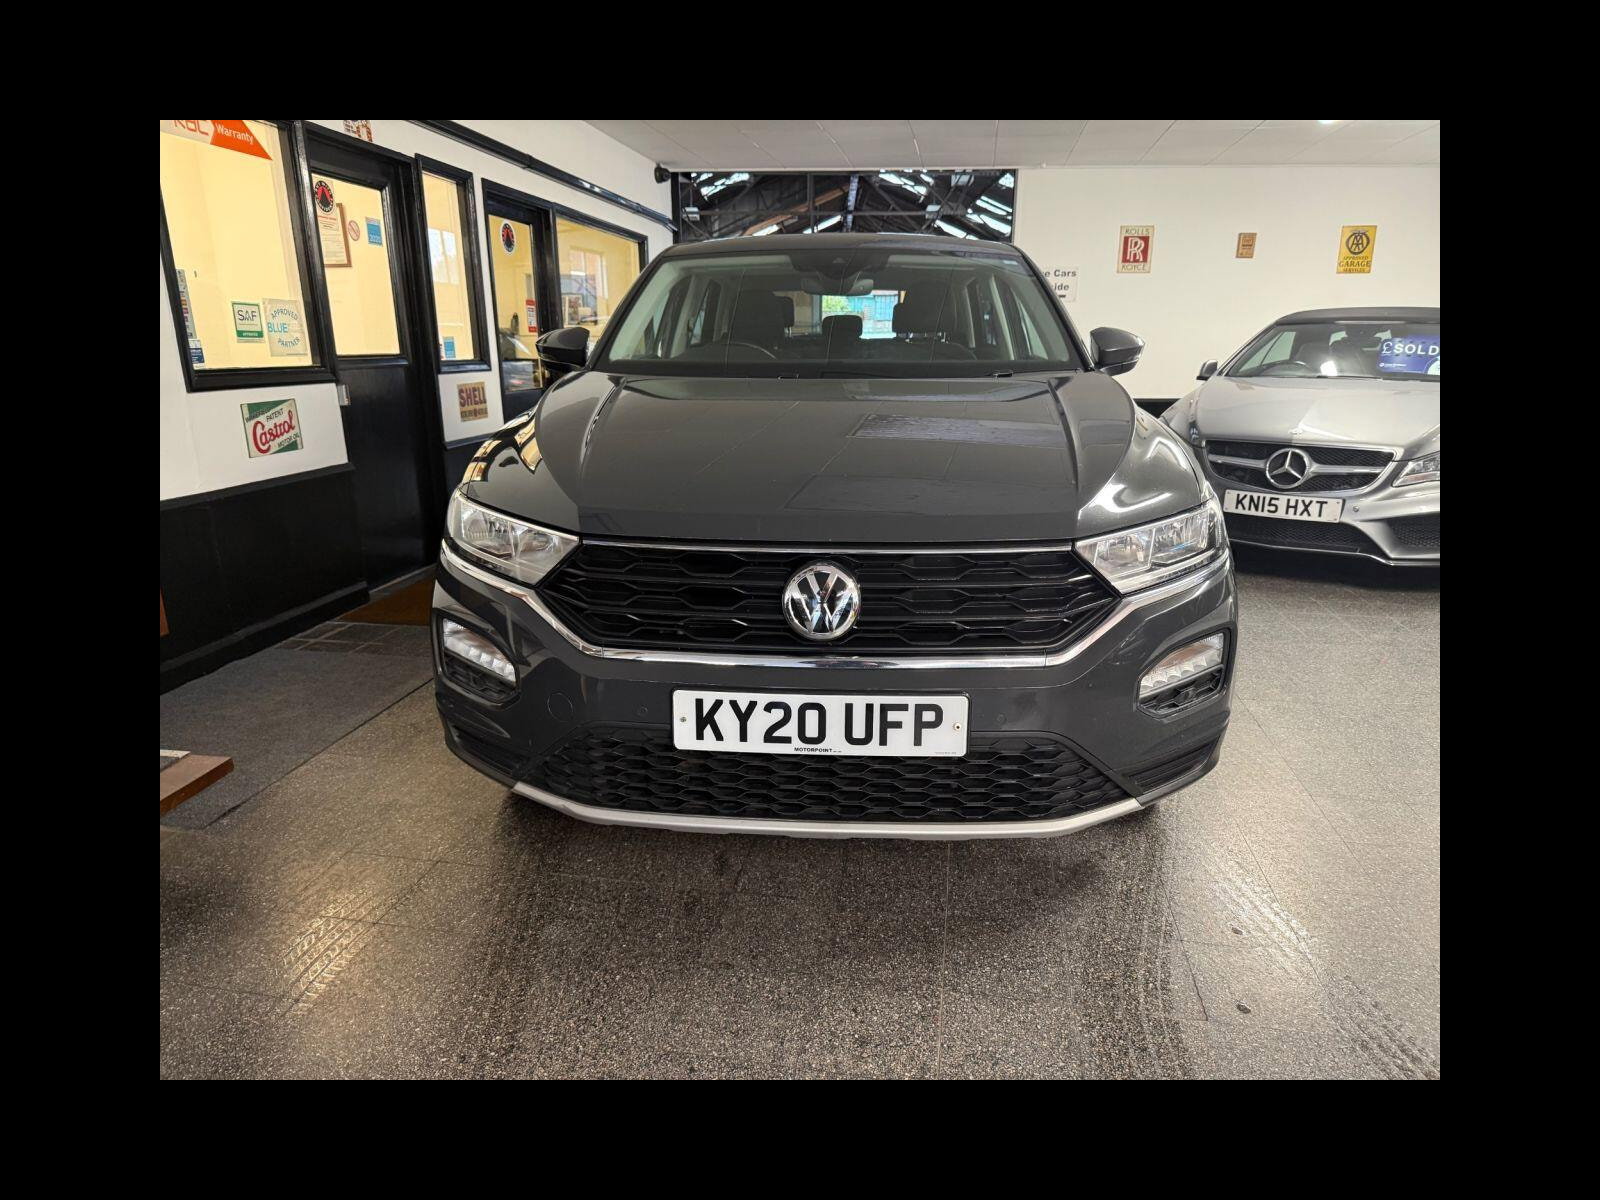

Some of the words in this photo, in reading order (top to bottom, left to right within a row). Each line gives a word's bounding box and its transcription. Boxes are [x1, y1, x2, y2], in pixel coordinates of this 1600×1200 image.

[215, 122, 254, 146] Warranty
[1124, 227, 1150, 235] ROLLS
[1053, 269, 1077, 278] Cars
[1121, 264, 1147, 272] ROYCE
[237, 310, 256, 322] SAF
[271, 308, 299, 320] APPROVED
[267, 322, 288, 333] BLUE
[277, 336, 300, 348] PARTNER
[459, 386, 486, 407] SHELL
[266, 408, 284, 422] PATENT
[252, 409, 296, 454] Castrol
[1235, 493, 1280, 514] KN15
[1285, 498, 1328, 518] HXT
[695, 698, 826, 746] KY20
[844, 702, 944, 747] UFP
